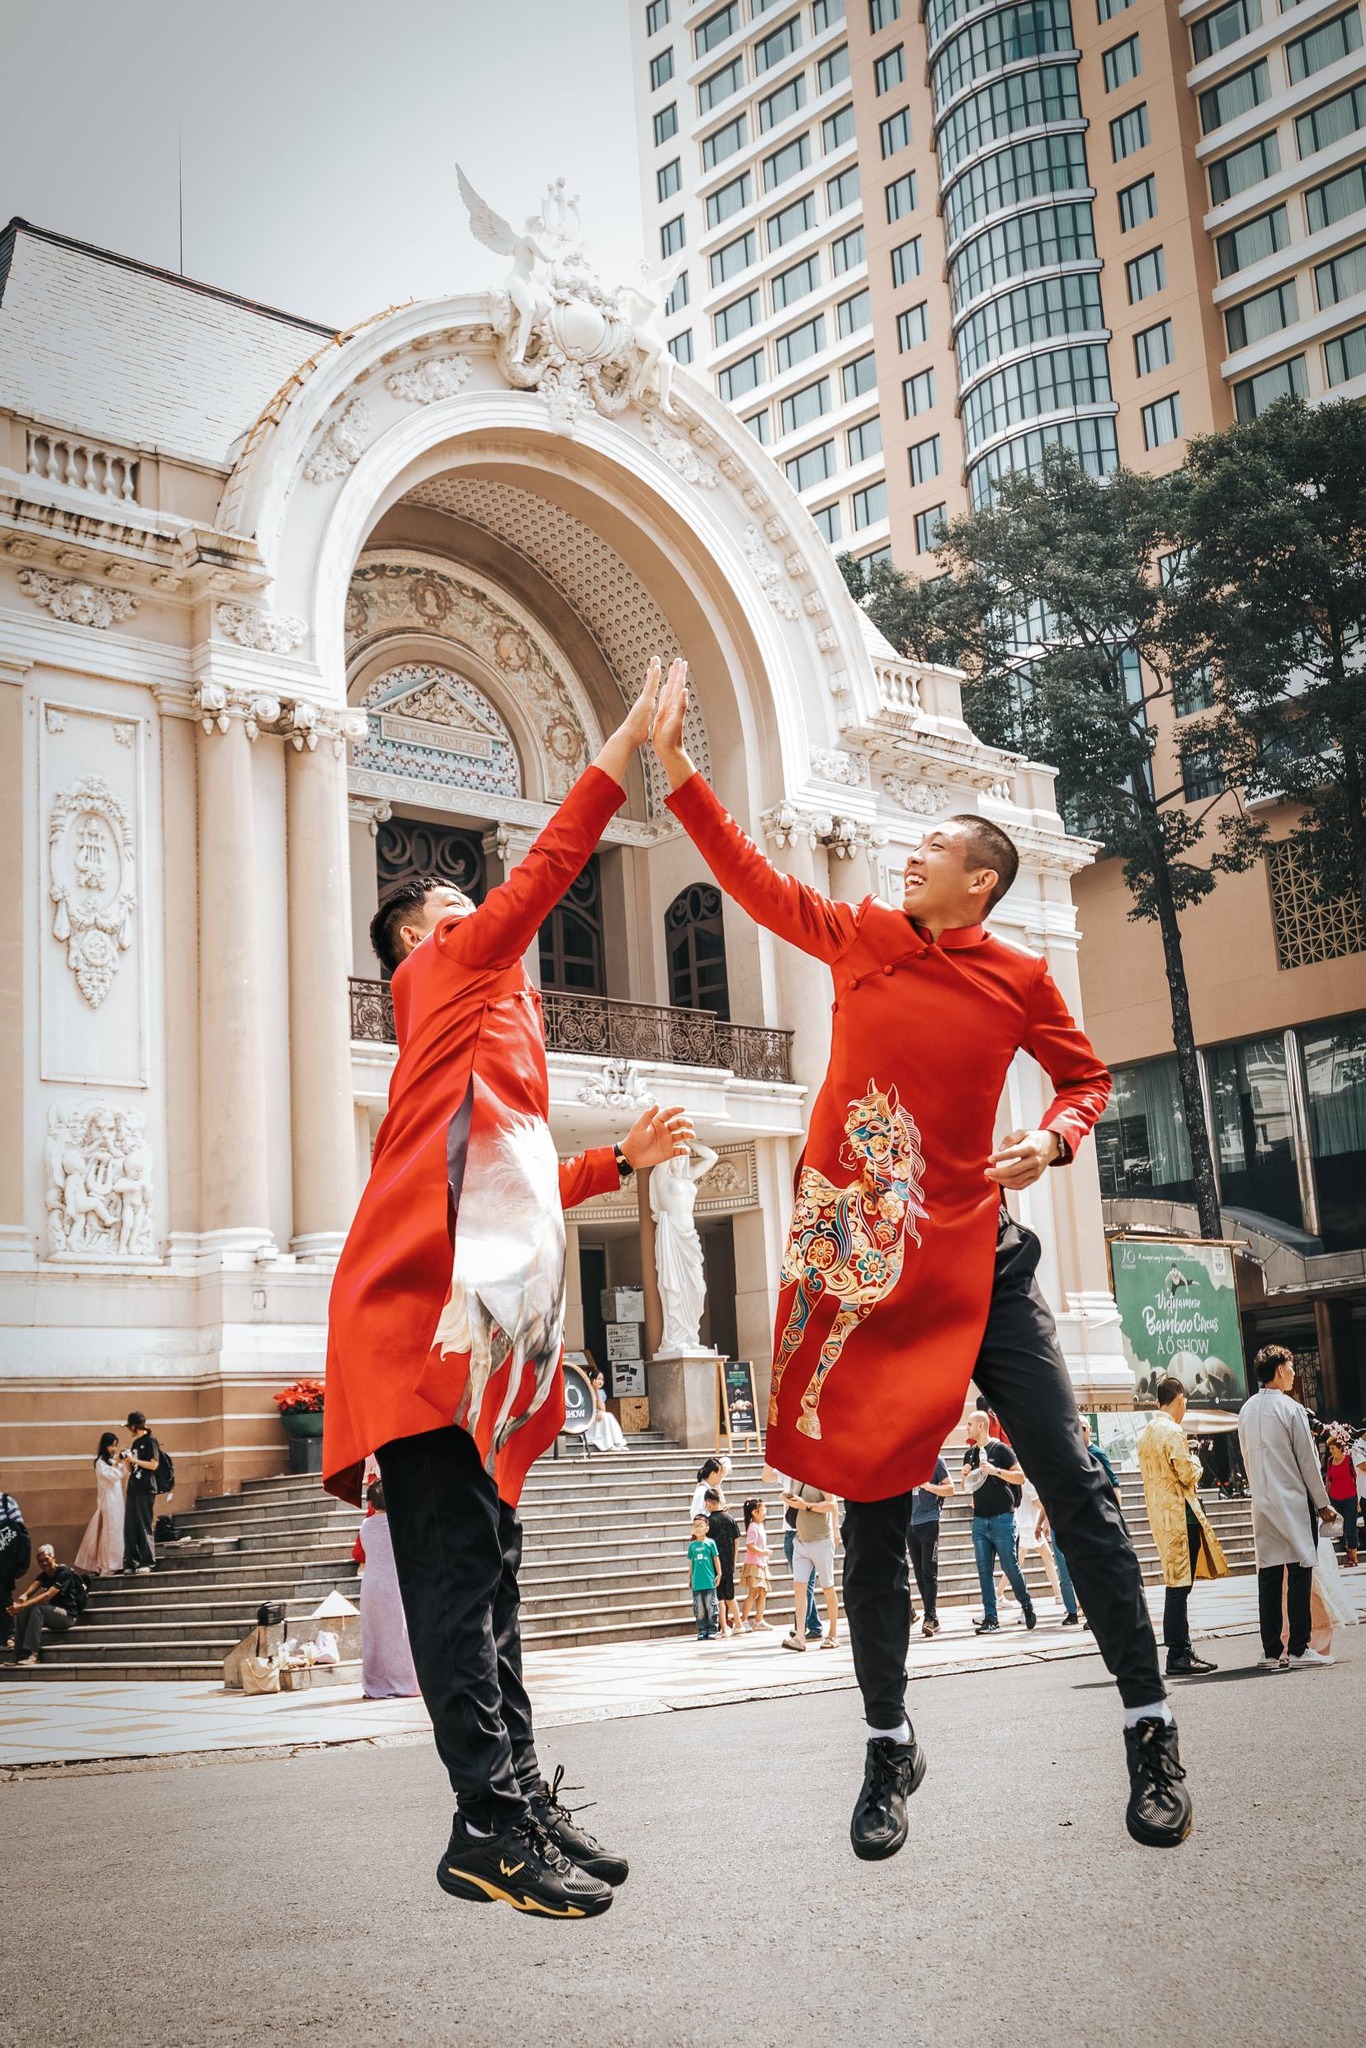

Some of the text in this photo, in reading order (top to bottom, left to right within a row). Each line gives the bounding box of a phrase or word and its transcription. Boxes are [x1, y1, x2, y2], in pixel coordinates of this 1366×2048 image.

[1155, 1289, 1201, 1311] Vietnamese
[1142, 1305, 1219, 1336] Bamboo Circus
[1176, 1338, 1210, 1355] SHOW
[565, 1409, 585, 1419] SHOW
